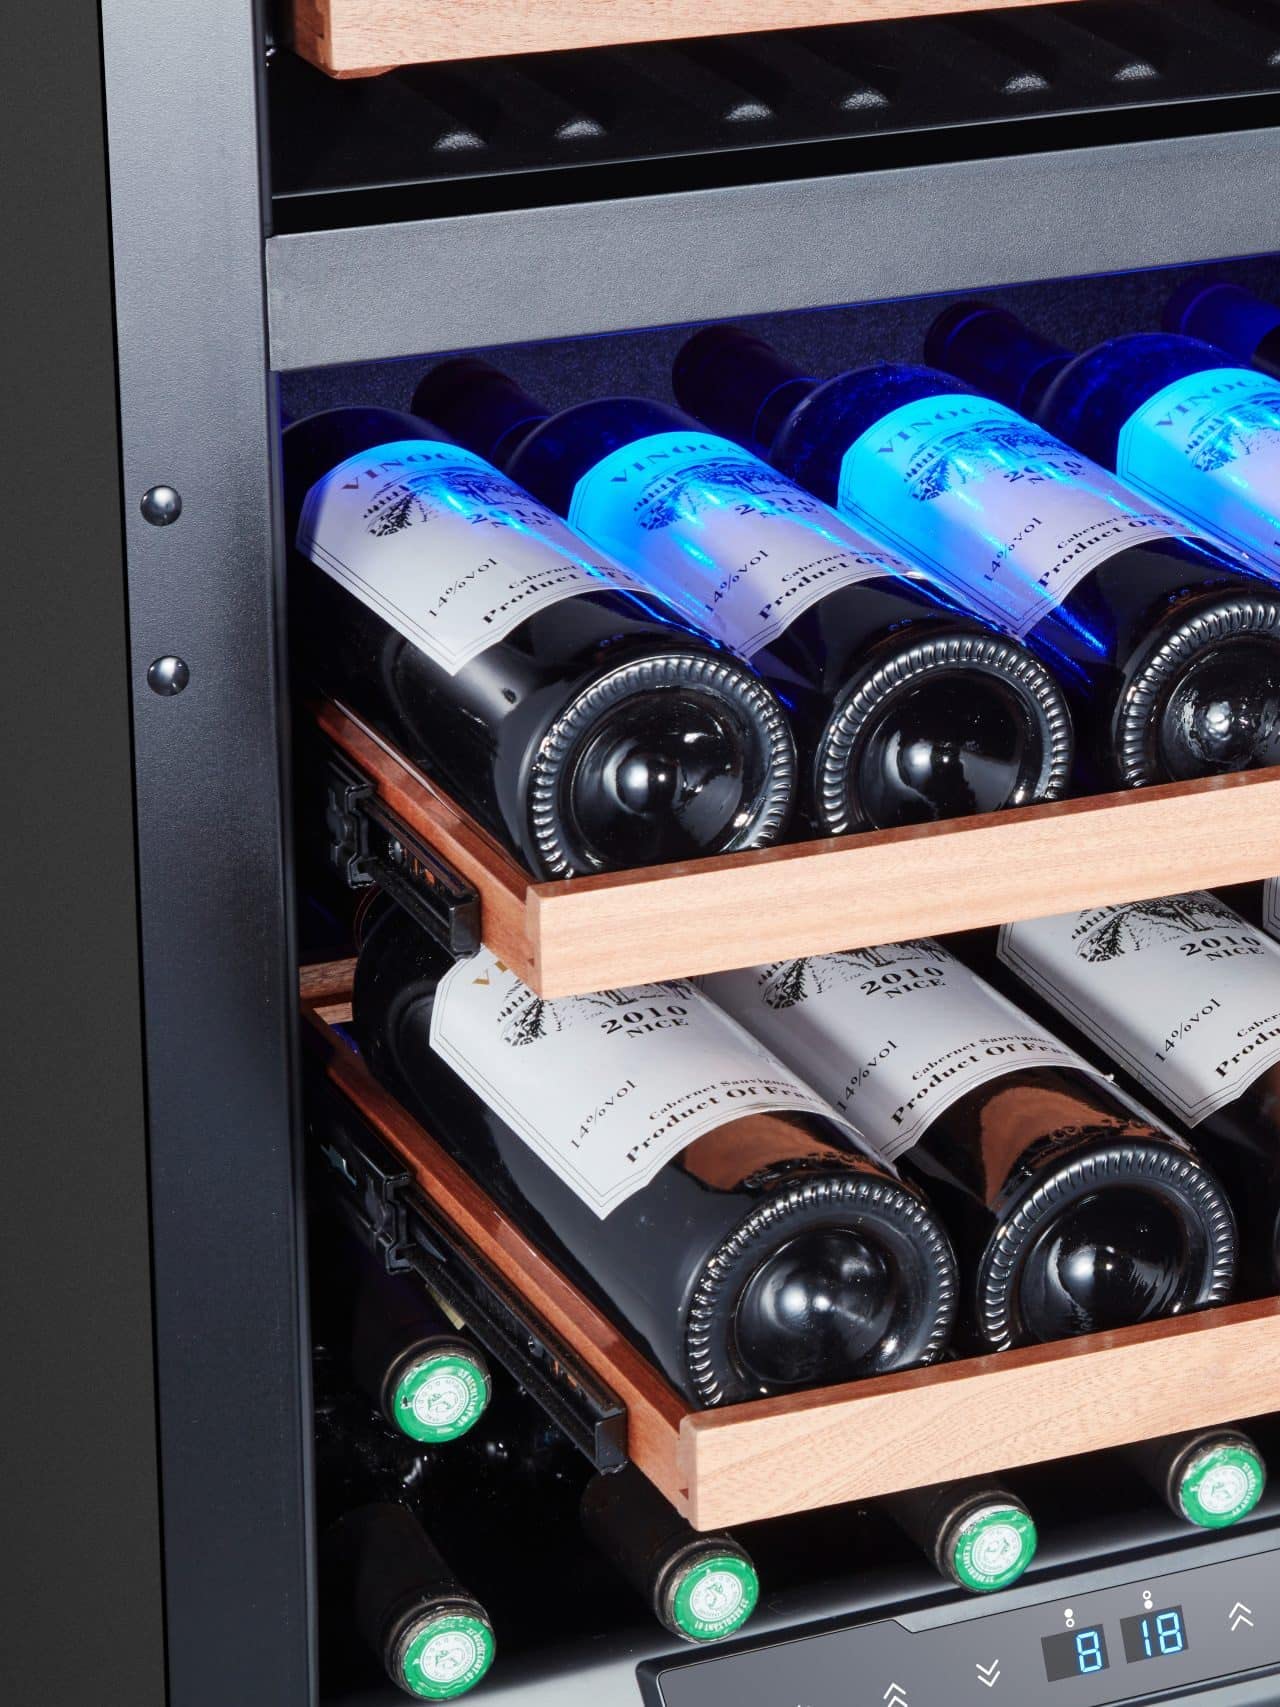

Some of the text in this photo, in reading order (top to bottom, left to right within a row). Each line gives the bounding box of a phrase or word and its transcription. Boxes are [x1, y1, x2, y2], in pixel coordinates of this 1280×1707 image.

[1028, 468, 1085, 485] NE
[1057, 516, 1119, 549] Cabernet
[508, 565, 578, 589] Cabernet
[781, 552, 847, 583] Cabernet
[1038, 526, 1124, 587] Product
[428, 557, 499, 617] 14%vol
[482, 573, 580, 624] Product
[705, 550, 769, 612] 14%vol
[757, 562, 851, 620] Product
[1180, 935, 1262, 957] 2010
[1207, 946, 1265, 962] NICE
[859, 966, 945, 996] 2010
[886, 979, 947, 999] NICE
[600, 1004, 688, 1035] 2010
[626, 1017, 689, 1039] NICE
[1154, 998, 1222, 1063] 14%vol
[838, 1040, 898, 1112] 14%vol
[911, 1038, 977, 1083] Cabernet
[648, 1081, 717, 1122] Cabernet
[890, 1054, 980, 1126] Product
[985, 1042, 1016, 1056] Of
[571, 1078, 639, 1151] 14%vol
[625, 1085, 816, 1165] Product Of Fra
[1075, 1630, 1103, 1673] 8
[1141, 1611, 1183, 1658] 18
